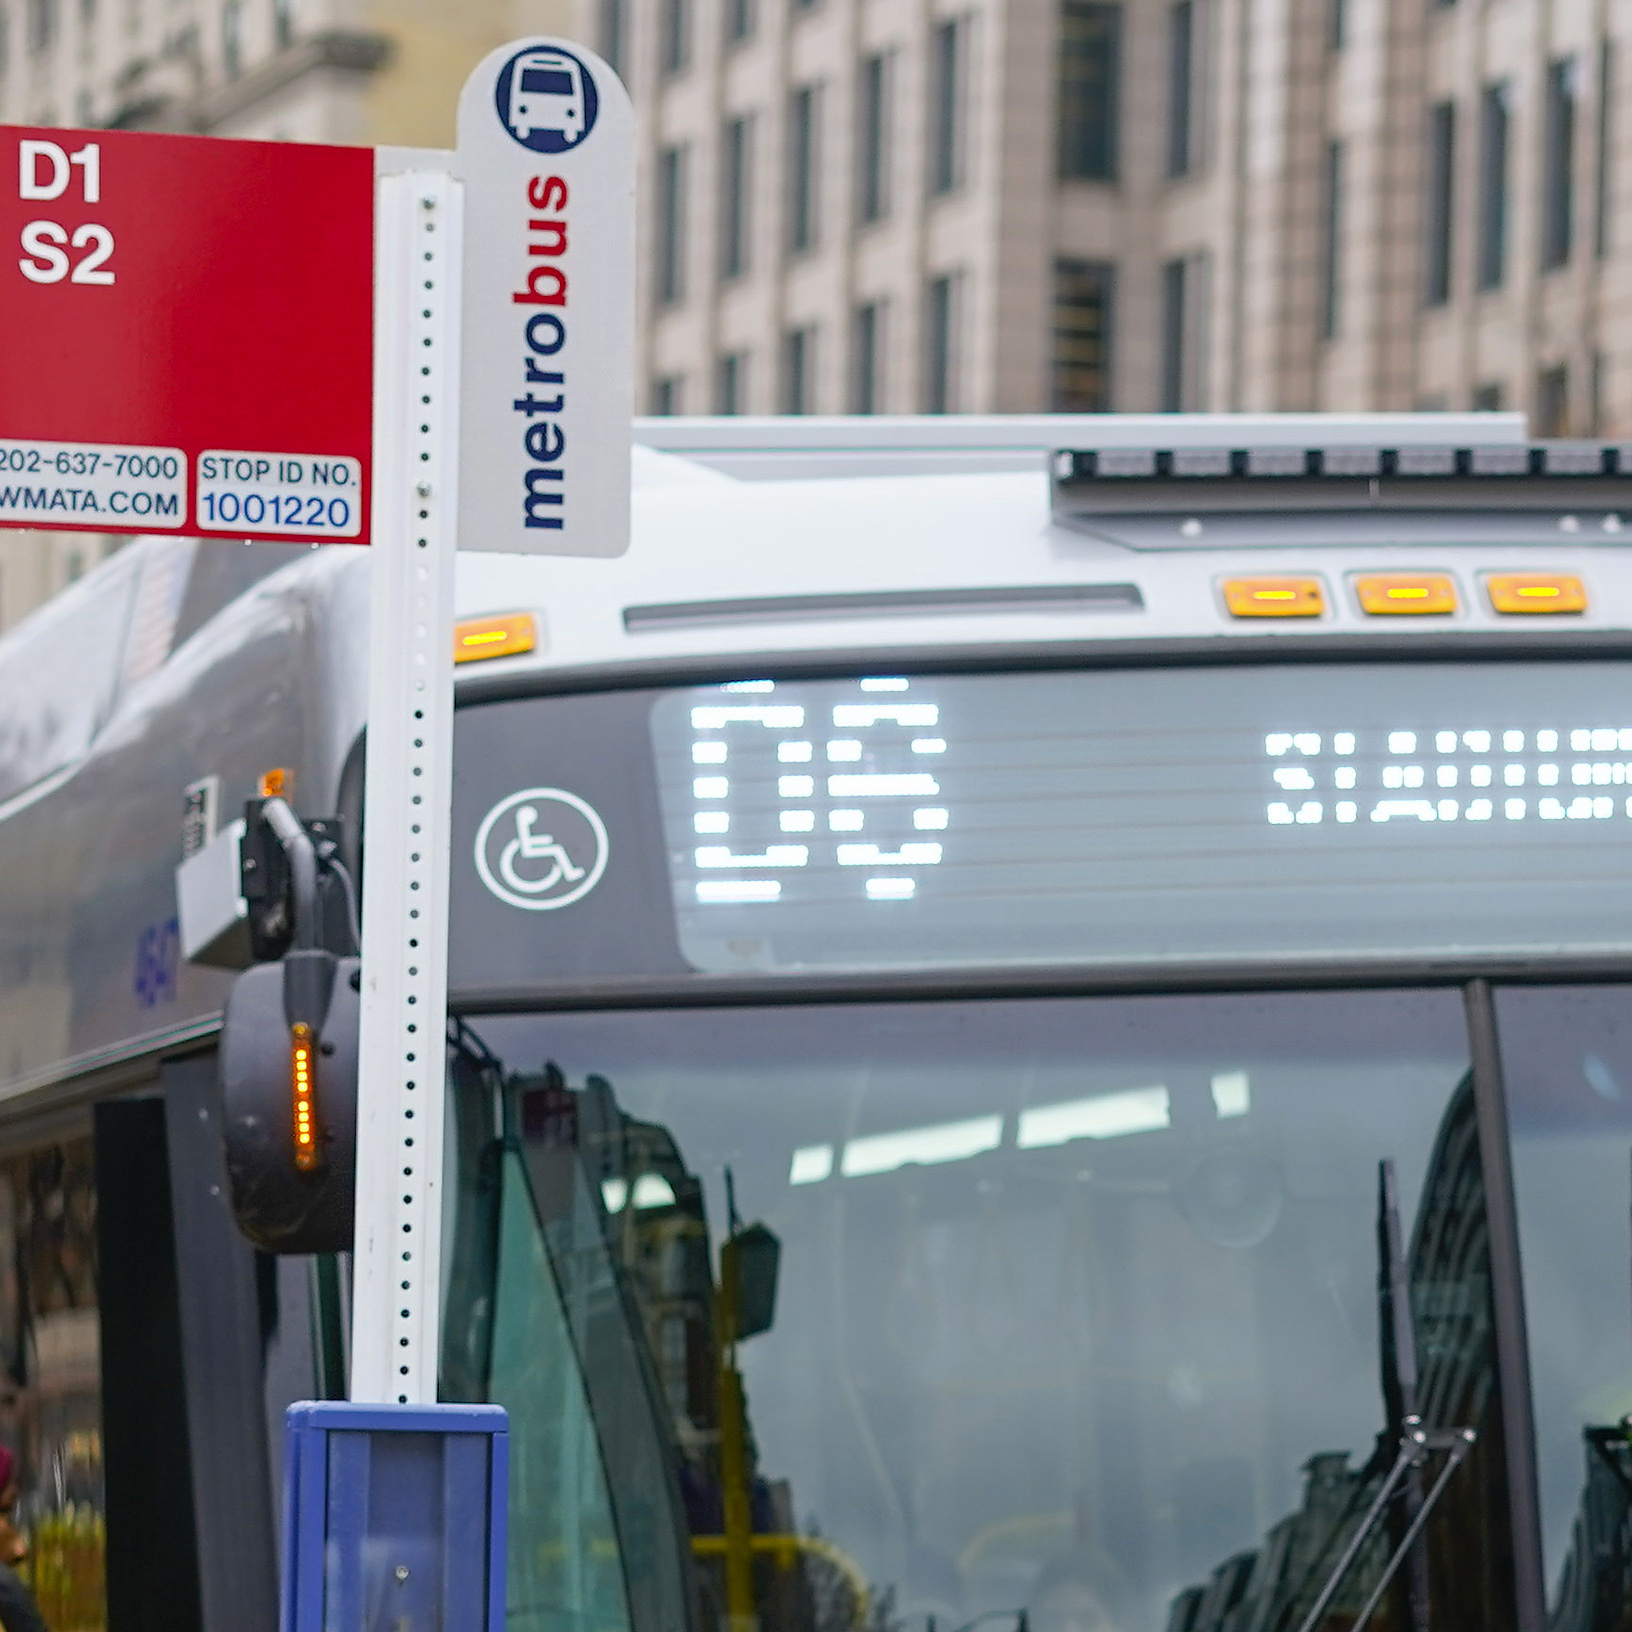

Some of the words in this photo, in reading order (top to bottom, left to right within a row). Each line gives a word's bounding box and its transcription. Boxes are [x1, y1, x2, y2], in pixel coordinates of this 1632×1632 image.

[19, 141, 101, 203] D1
[18, 221, 117, 286] S2
[512, 174, 568, 531] metrobus
[202, 456, 270, 482] STOP
[279, 460, 303, 484] ID
[312, 462, 357, 487] NO.
[202, 491, 351, 528] 1001220
